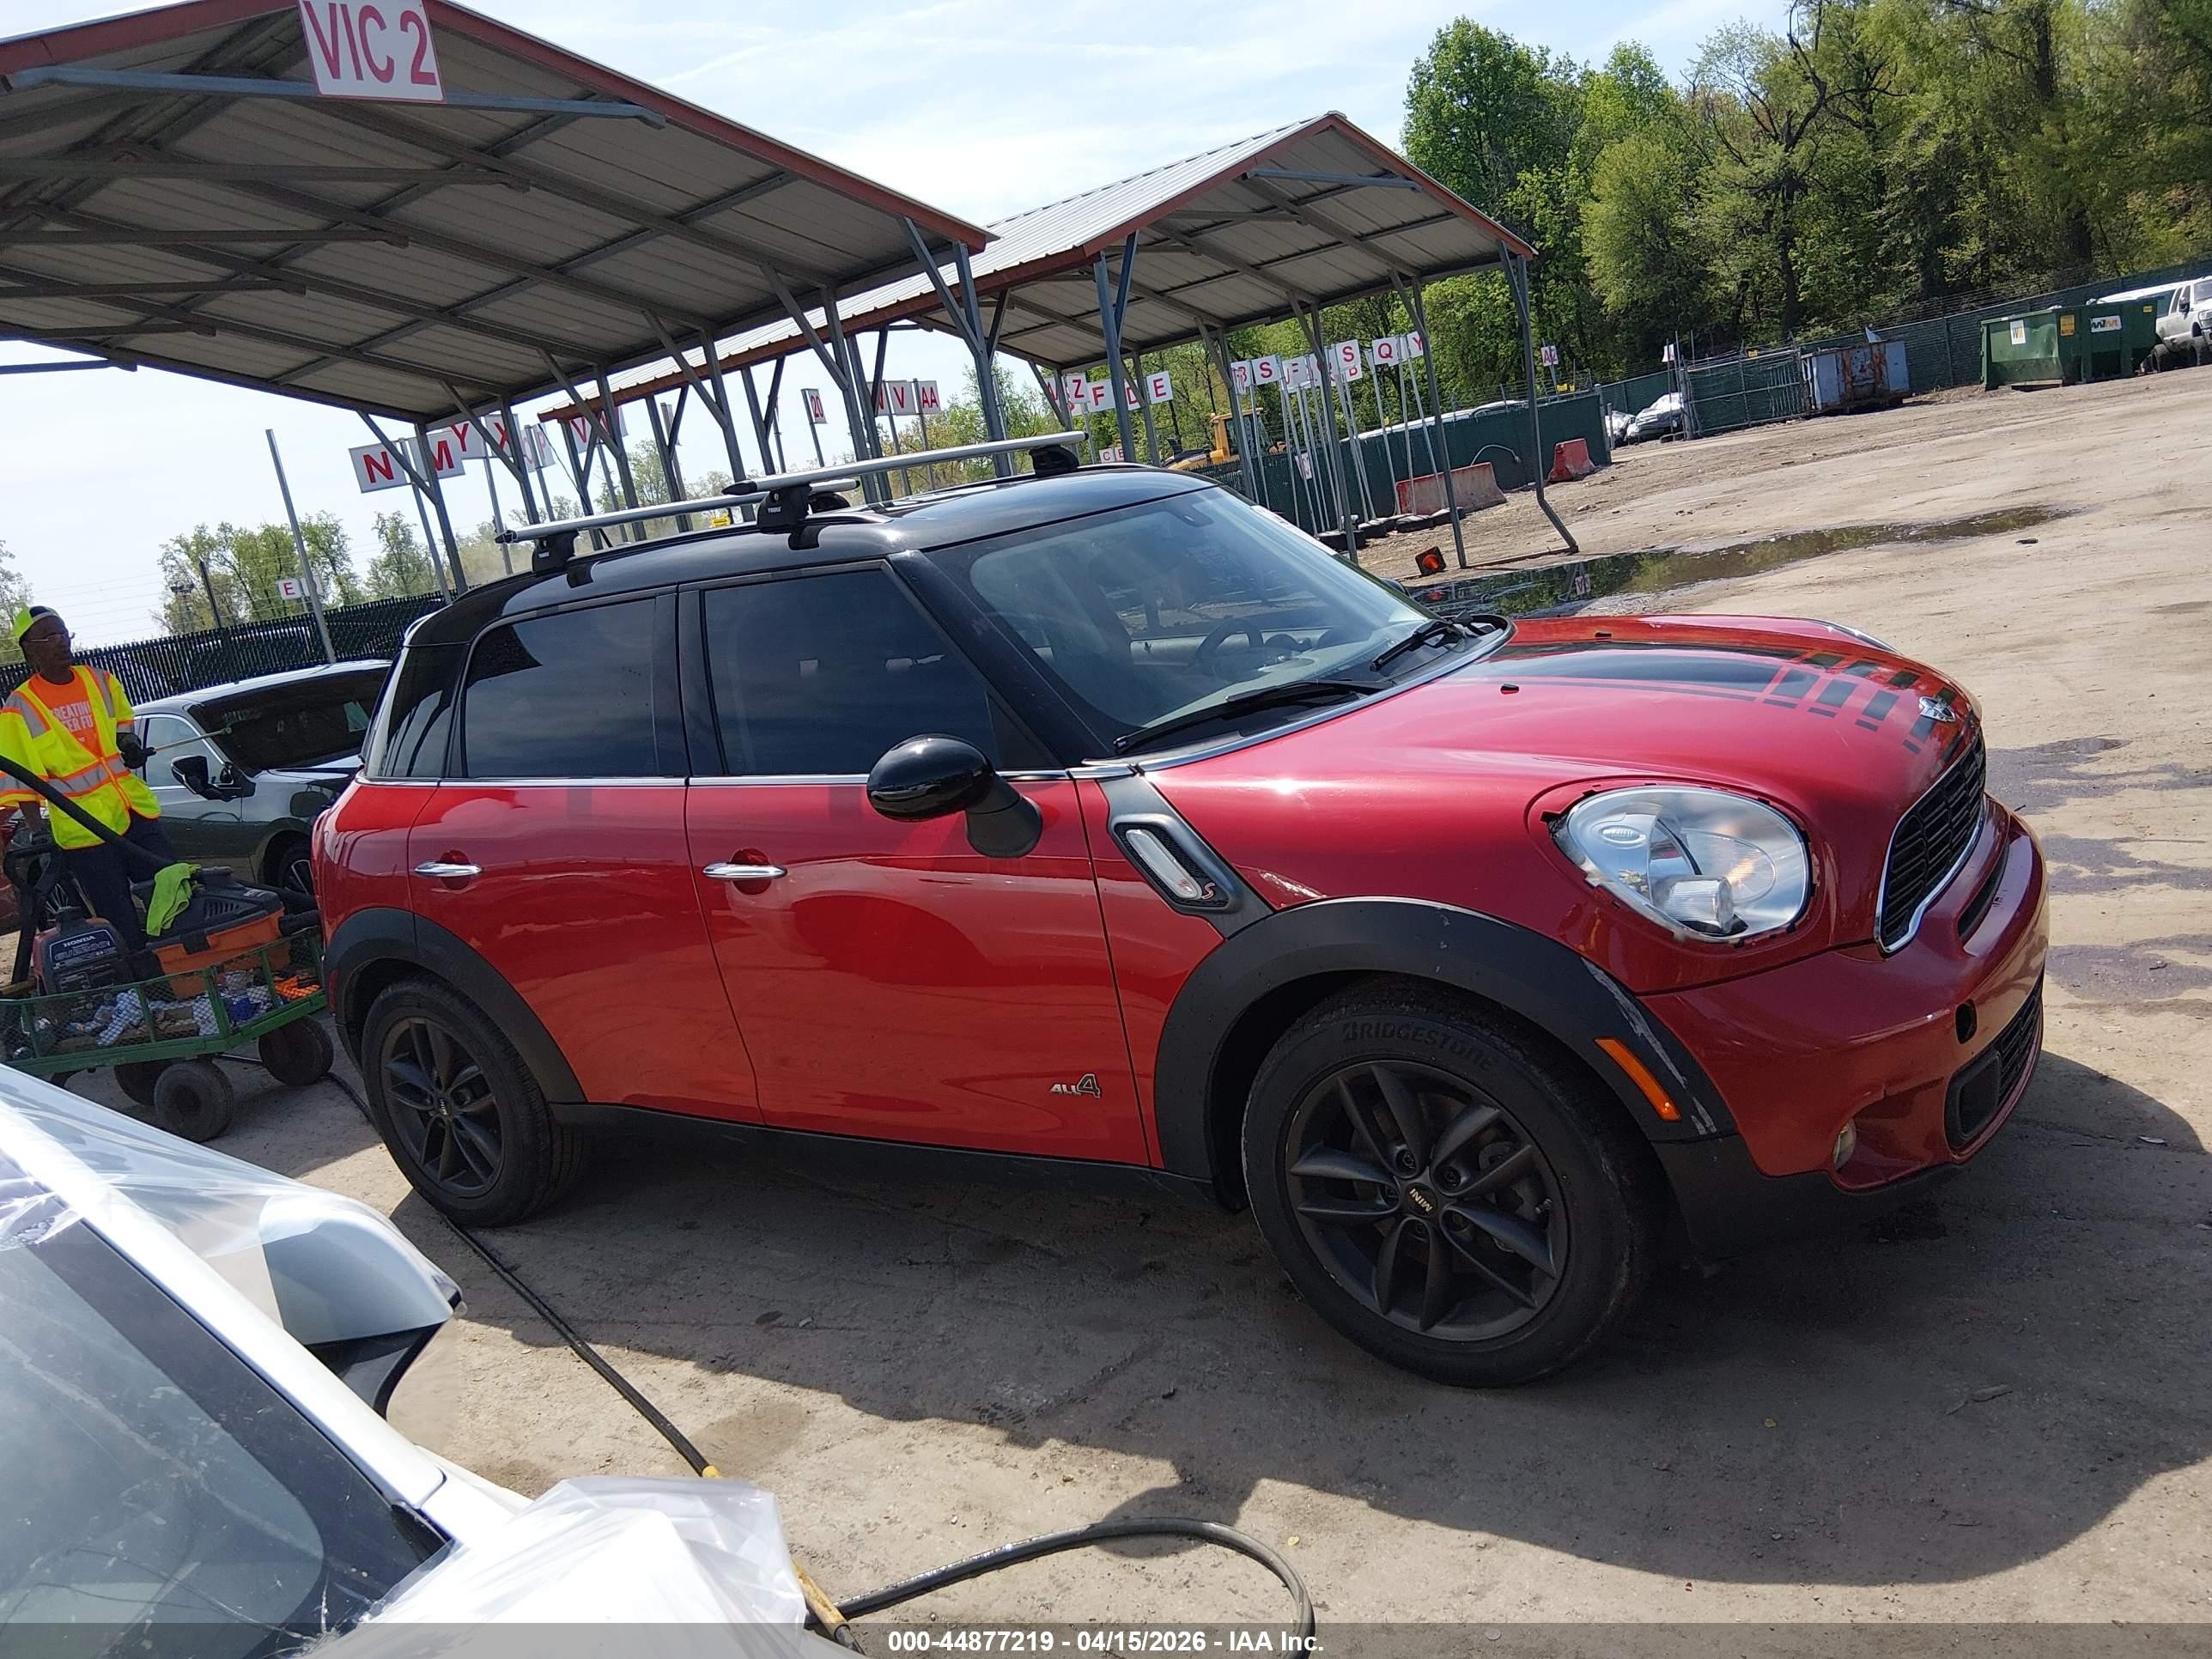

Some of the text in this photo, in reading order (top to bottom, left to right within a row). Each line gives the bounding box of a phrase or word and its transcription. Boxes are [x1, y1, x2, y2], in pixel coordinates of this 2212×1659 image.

[303, 0, 437, 86] VIC 2
[1342, 346, 1354, 362] S
[1377, 343, 1393, 359] Q
[1259, 362, 1273, 379] S
[893, 386, 904, 409] V
[921, 386, 939, 409] AA
[1073, 379, 1085, 398] Z
[1091, 385, 1105, 406] F
[1152, 378, 1167, 398] E
[811, 395, 824, 418] 20
[450, 423, 470, 452] Y
[1103, 451, 1111, 461] C
[362, 451, 394, 483] N
[283, 581, 296, 596] E
[1200, 882, 1215, 900] S
[63, 935, 96, 947] HONDA
[1341, 1020, 1498, 1071] BRIDGESTONE
[1409, 1188, 1433, 1212] MINI
